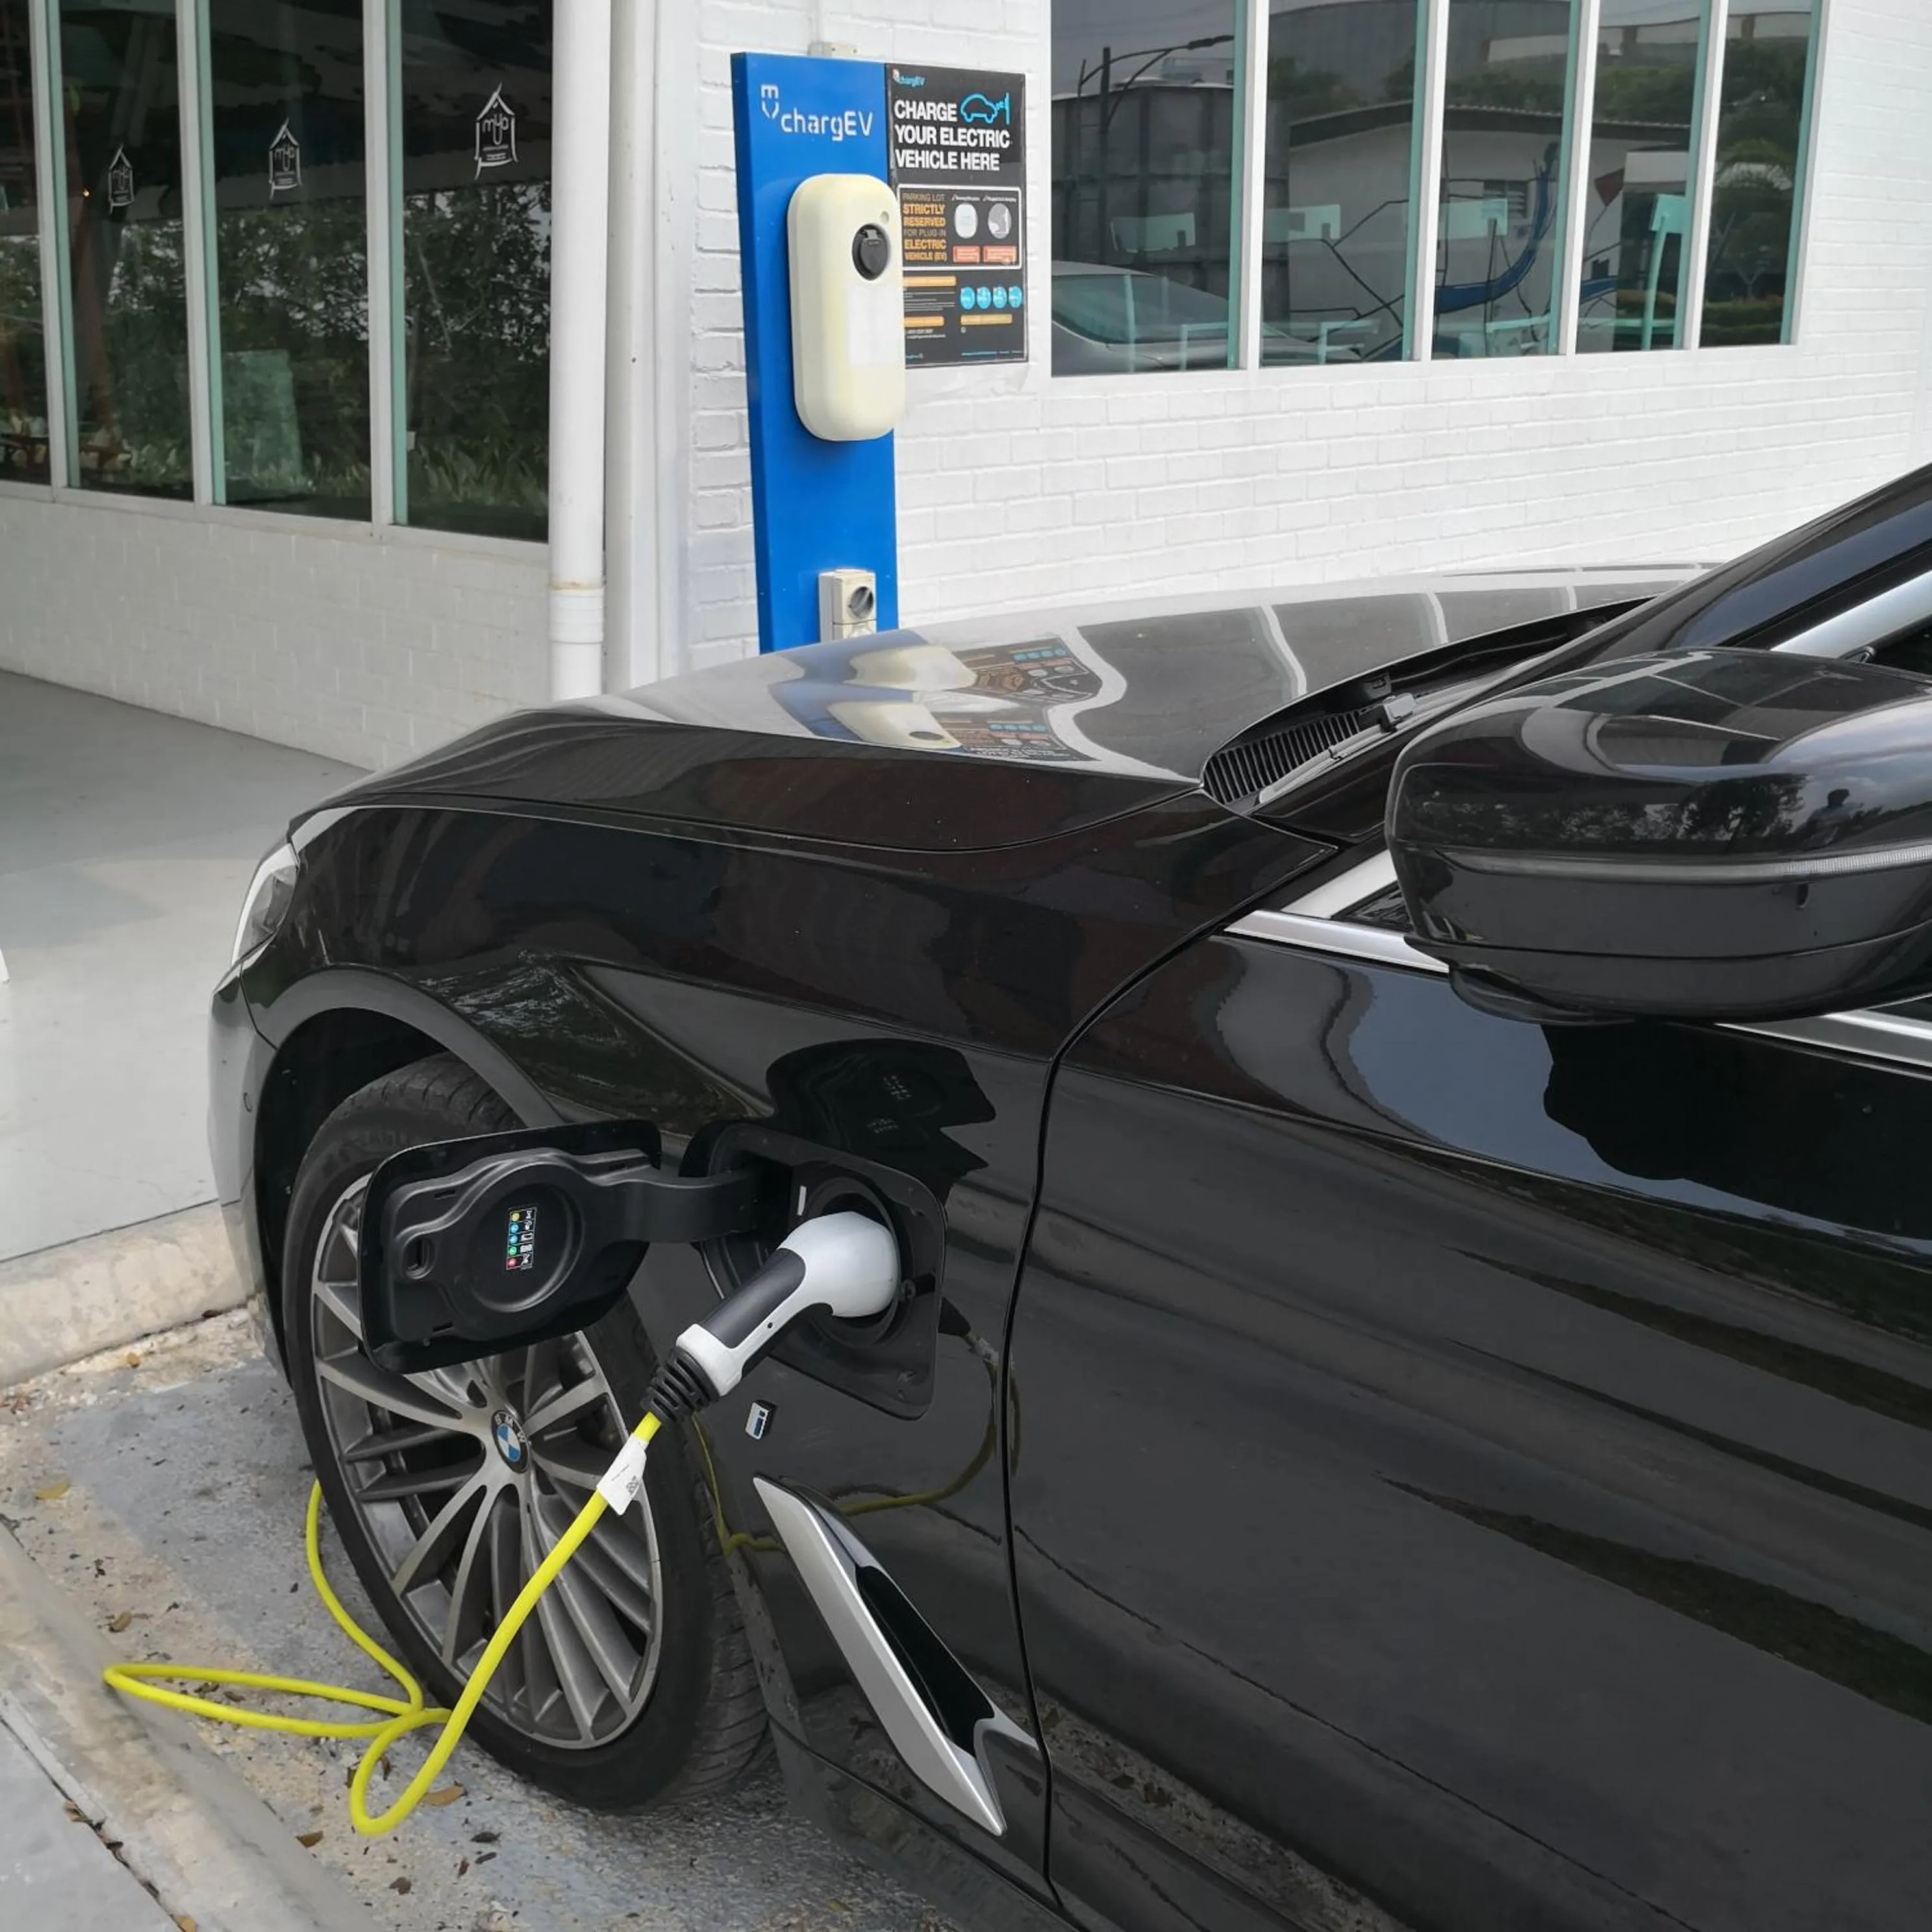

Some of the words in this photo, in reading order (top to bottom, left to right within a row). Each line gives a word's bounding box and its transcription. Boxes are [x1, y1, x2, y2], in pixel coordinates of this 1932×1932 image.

[894, 99, 958, 122] CHARGE
[781, 107, 873, 142] chargEV
[894, 124, 937, 145] YOUR
[939, 127, 1010, 148] ELECTRIC
[895, 149, 958, 169] VEHICLE
[960, 152, 1000, 171] HERE
[903, 203, 946, 215] STRICTLY
[903, 216, 946, 227] RESERVED
[904, 239, 947, 250] ELECTRIC
[904, 251, 934, 261] VEHICLE
[494, 1413, 526, 1443] BMW
